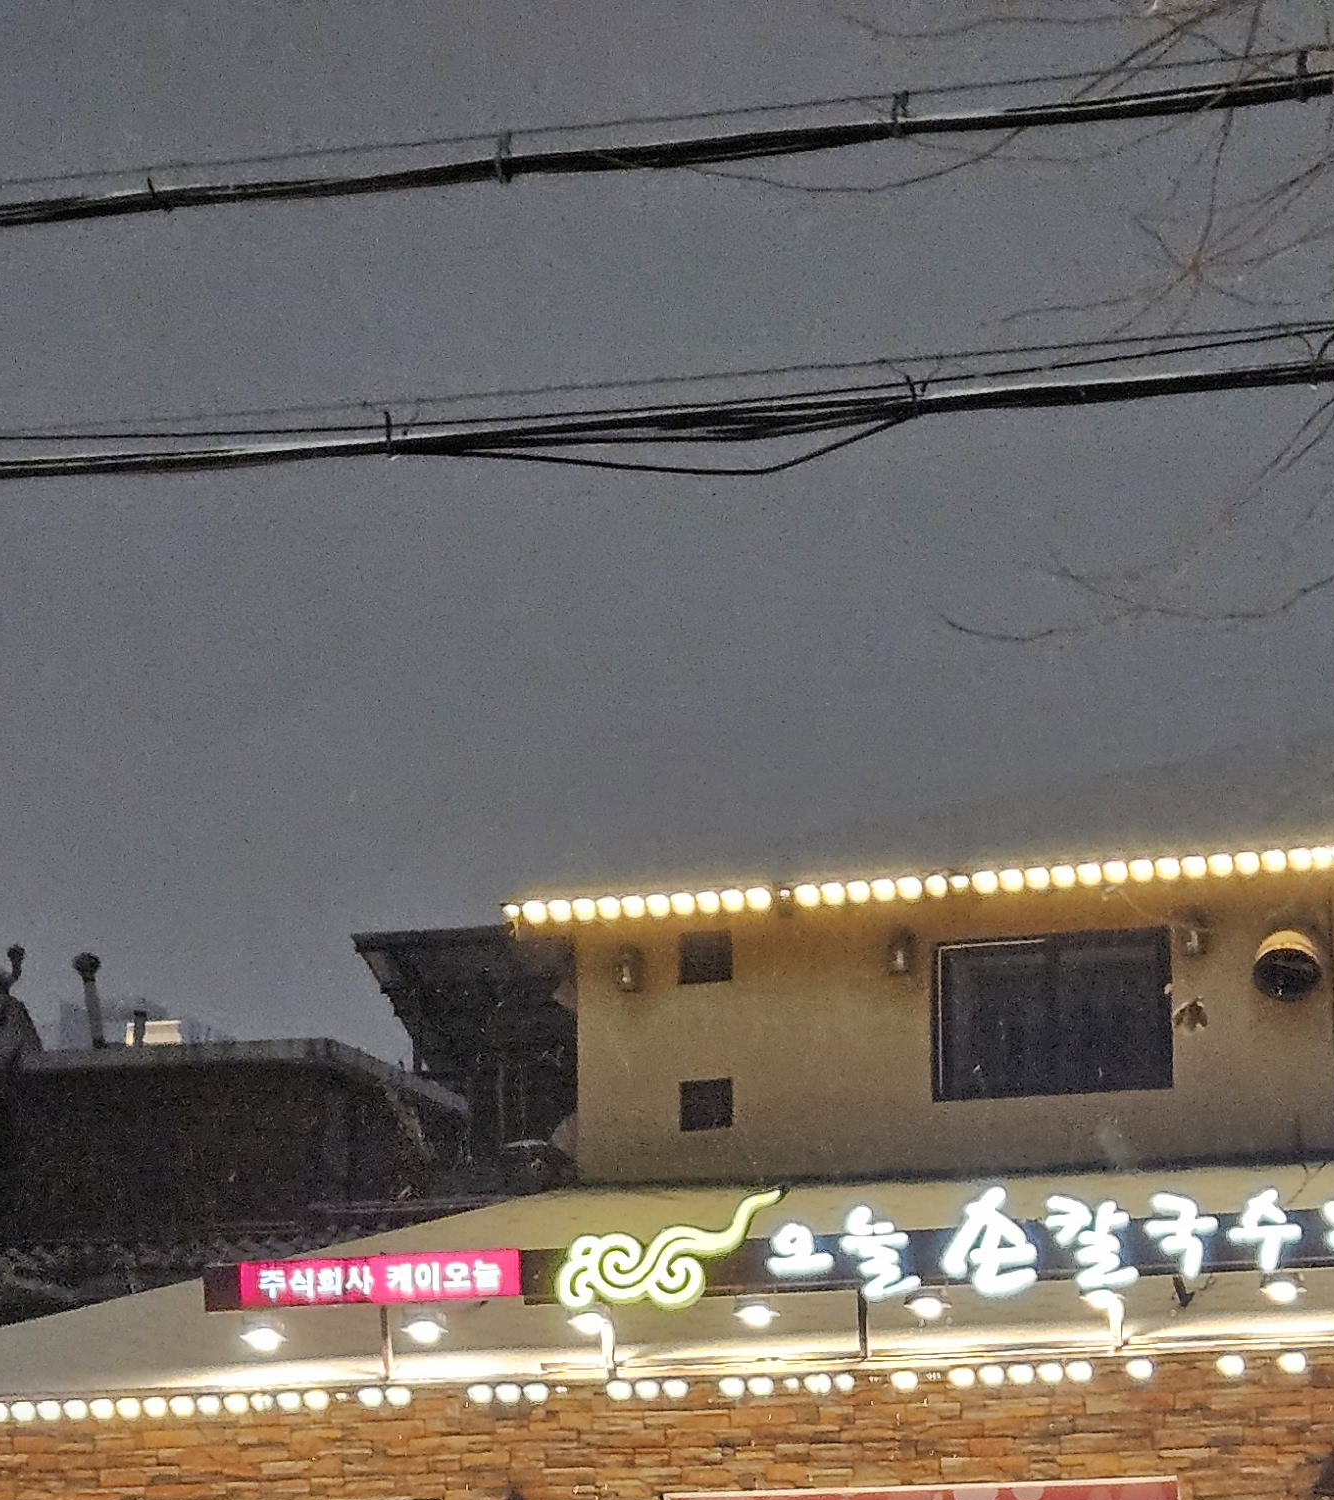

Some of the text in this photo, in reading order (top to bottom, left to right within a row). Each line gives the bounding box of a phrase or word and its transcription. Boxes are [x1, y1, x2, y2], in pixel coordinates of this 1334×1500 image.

[258, 1259, 502, 1302] 주식회사 케이오늘
[765, 1203, 924, 1300] 오늘
